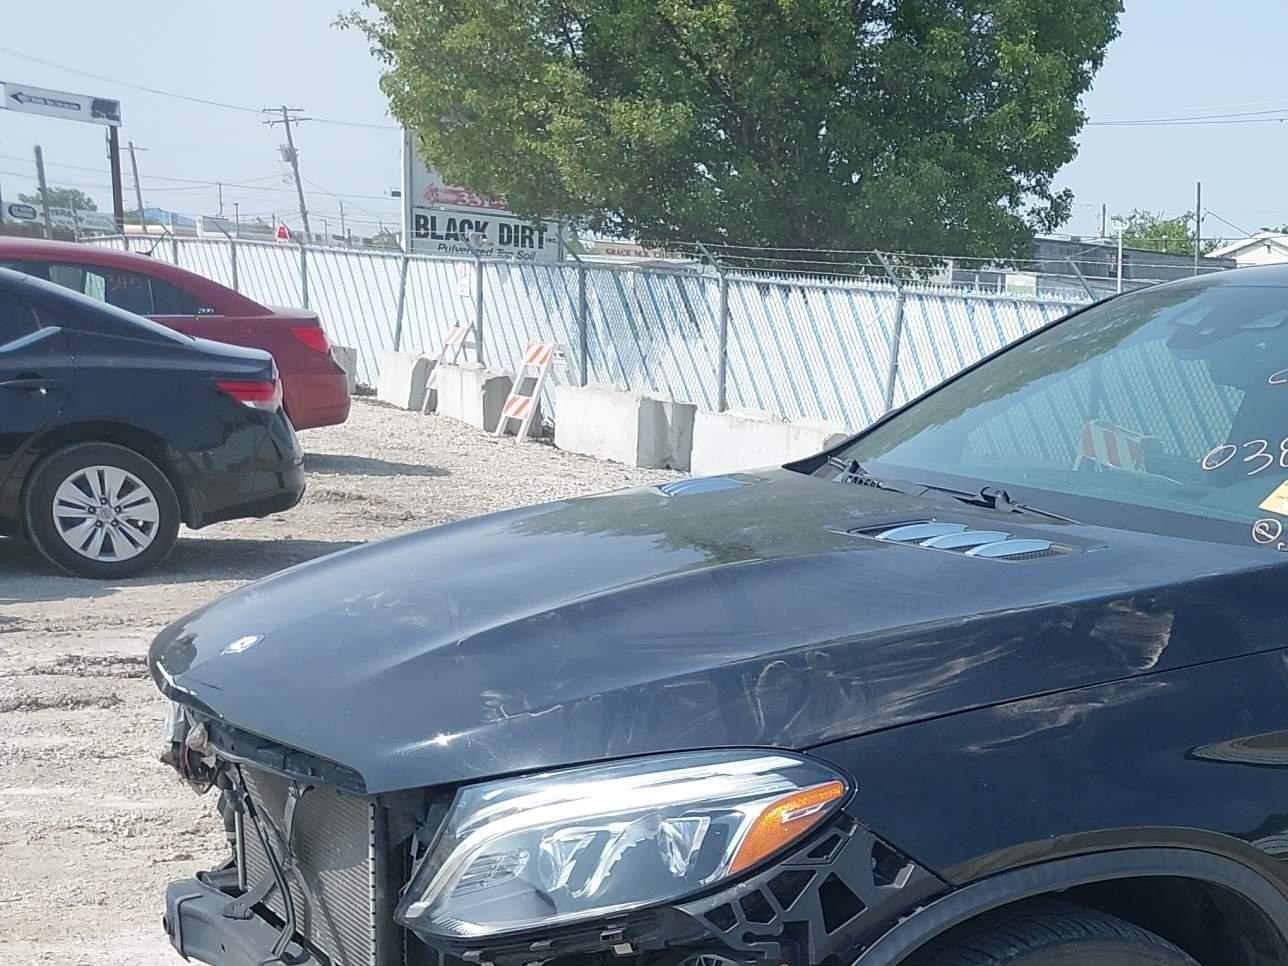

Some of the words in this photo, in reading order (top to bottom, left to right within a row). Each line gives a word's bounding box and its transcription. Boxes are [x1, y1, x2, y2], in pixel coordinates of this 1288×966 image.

[415, 214, 489, 242] BLACK
[499, 223, 548, 249] DIRT
[517, 250, 537, 261] Soil
[605, 248, 632, 257] GRACE
